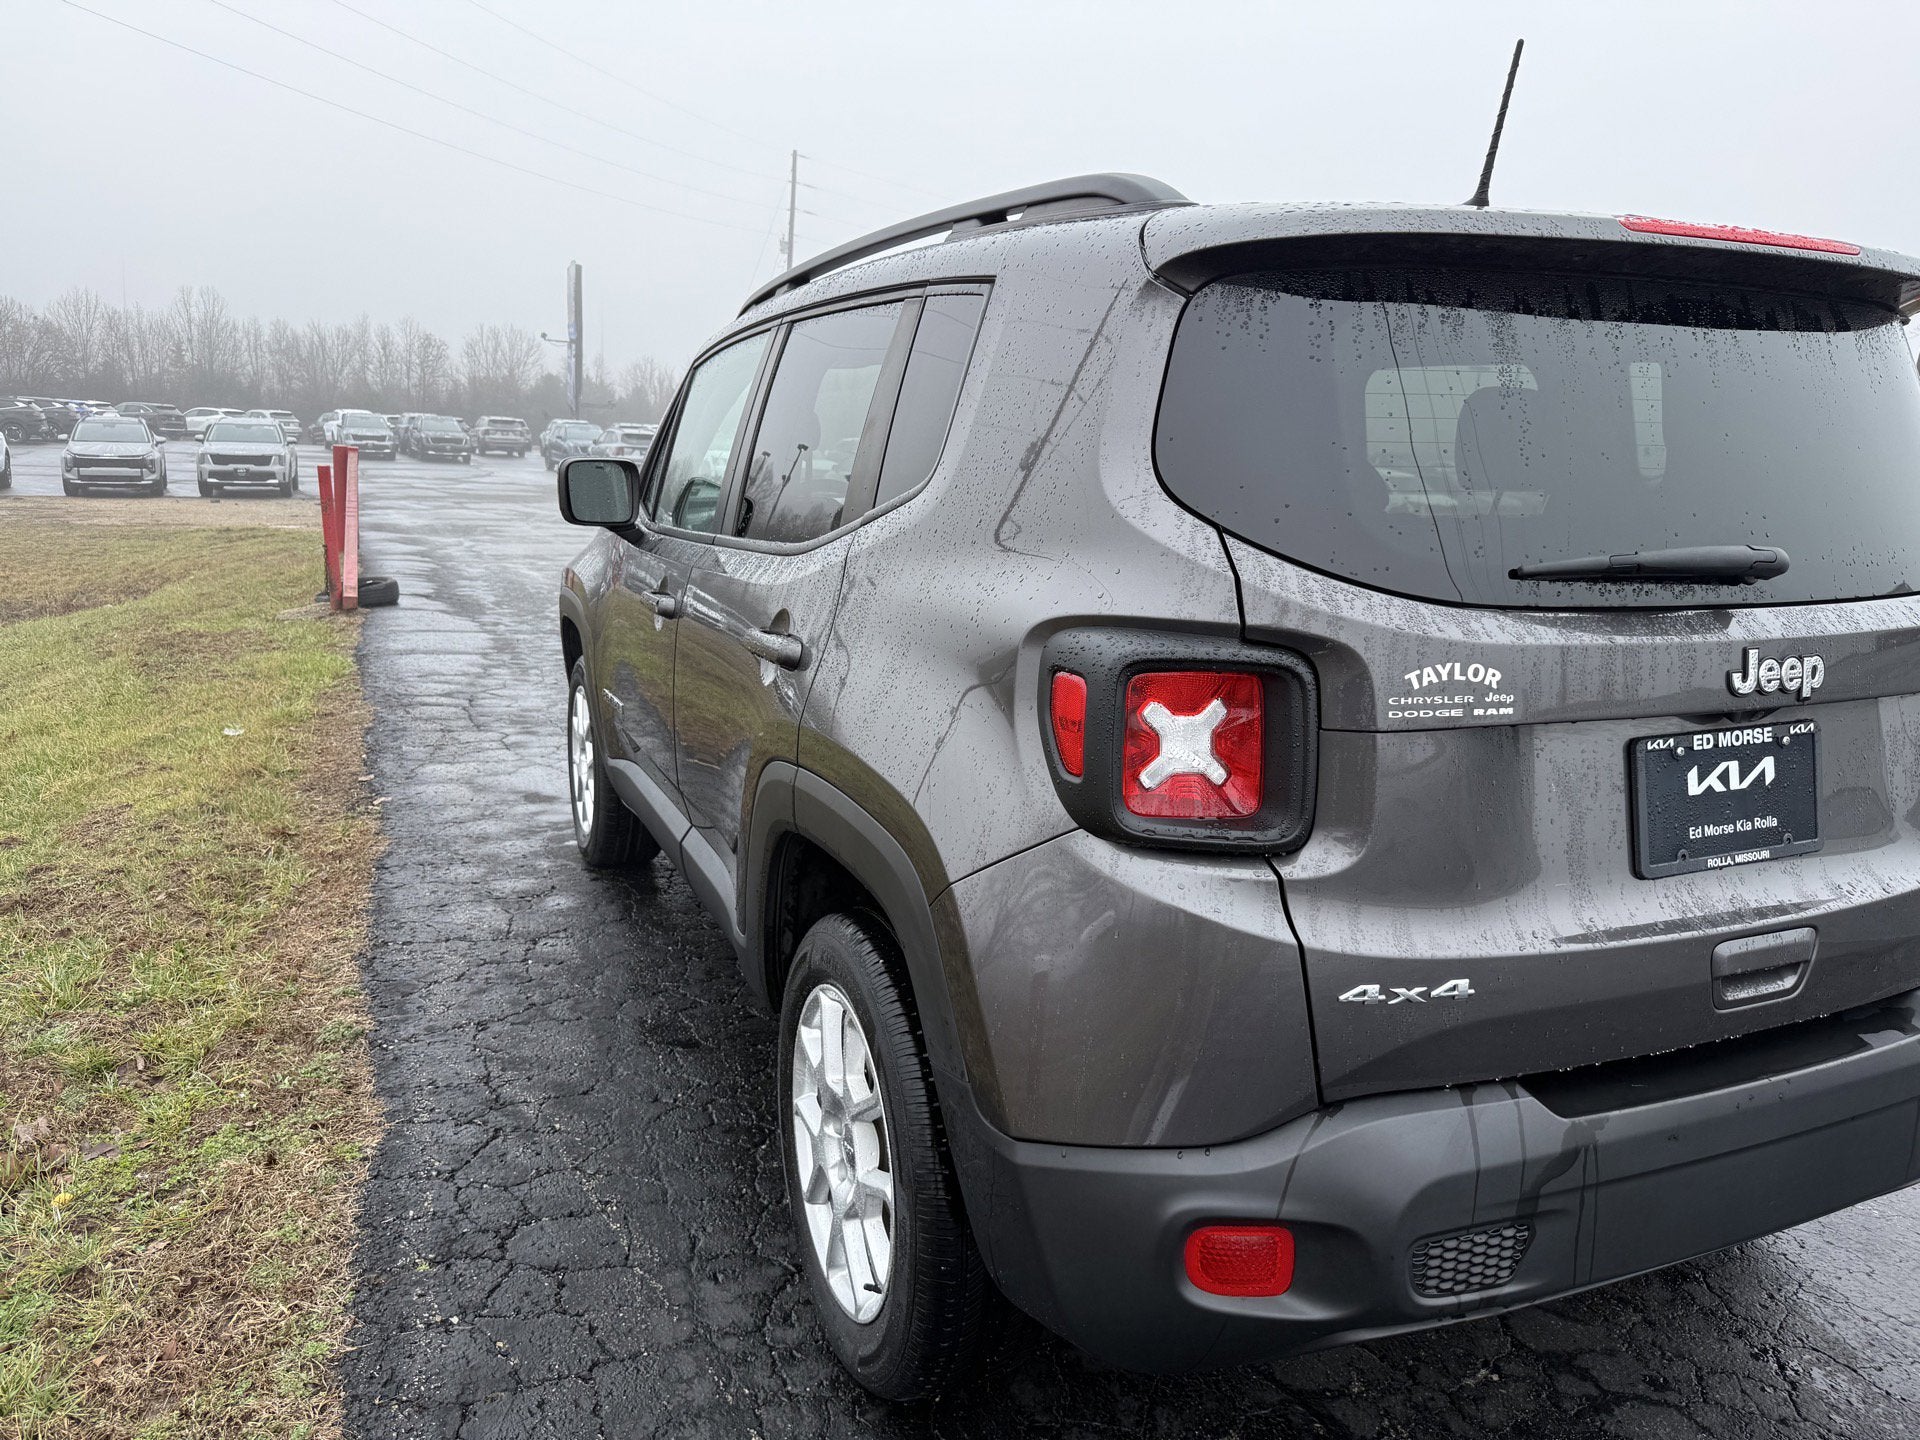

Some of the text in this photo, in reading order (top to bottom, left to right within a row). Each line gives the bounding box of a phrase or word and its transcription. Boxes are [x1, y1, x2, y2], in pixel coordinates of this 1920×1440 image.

[1404, 662, 1502, 690] TAYLOR
[1729, 648, 1825, 698] Jeep
[1388, 691, 1515, 705] CHRYSLER Jeep
[1388, 707, 1514, 718] DODGE RAM
[1693, 727, 1773, 750] ED MORSE
[1789, 722, 1815, 735] KIA
[1647, 738, 1675, 750] KIA
[1687, 756, 1776, 796] KIA
[1689, 816, 1778, 840] Ed Morse Kia Rolla
[1707, 850, 1770, 868] ROLLA, MISSOURI
